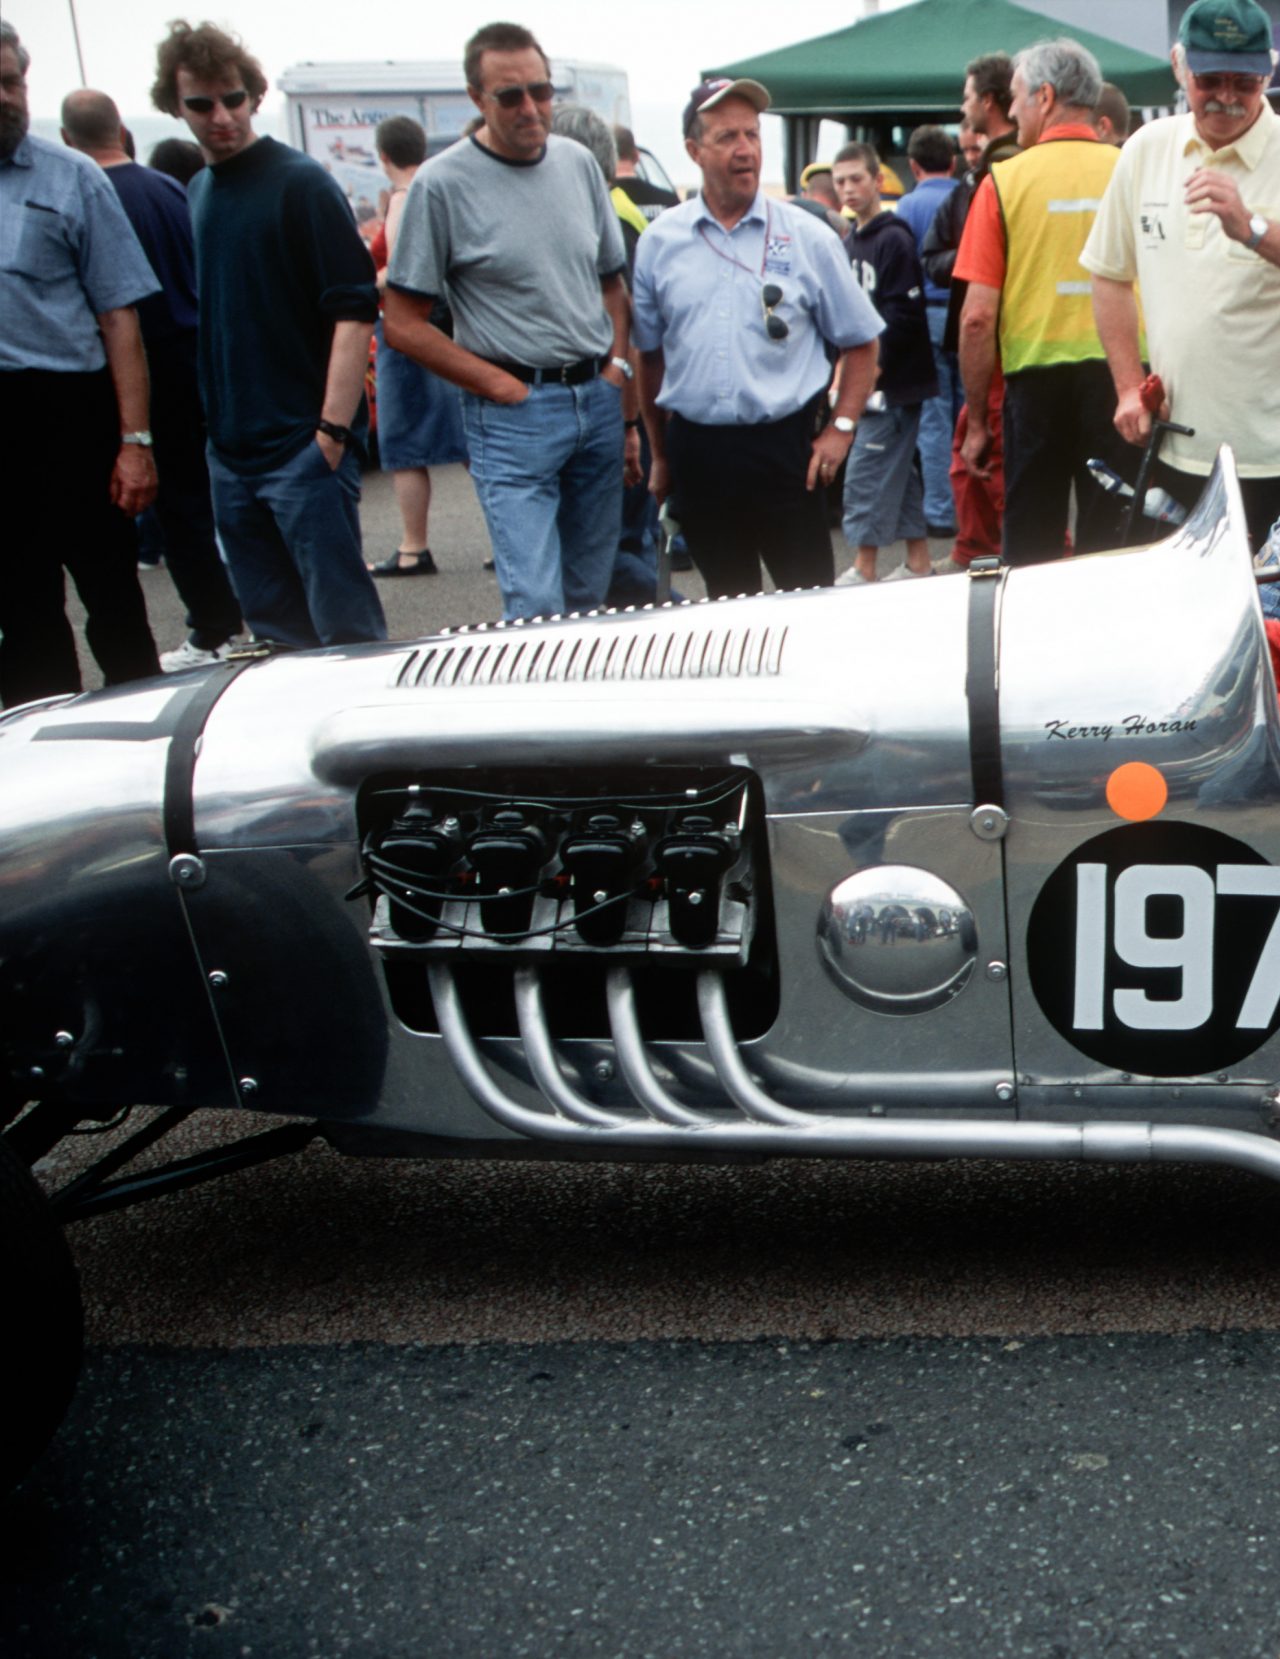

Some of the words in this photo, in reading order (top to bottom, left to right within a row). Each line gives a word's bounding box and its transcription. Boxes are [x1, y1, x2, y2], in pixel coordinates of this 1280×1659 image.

[312, 109, 345, 126] The
[1045, 719, 1113, 742] Kerry
[1121, 714, 1198, 736] Horan
